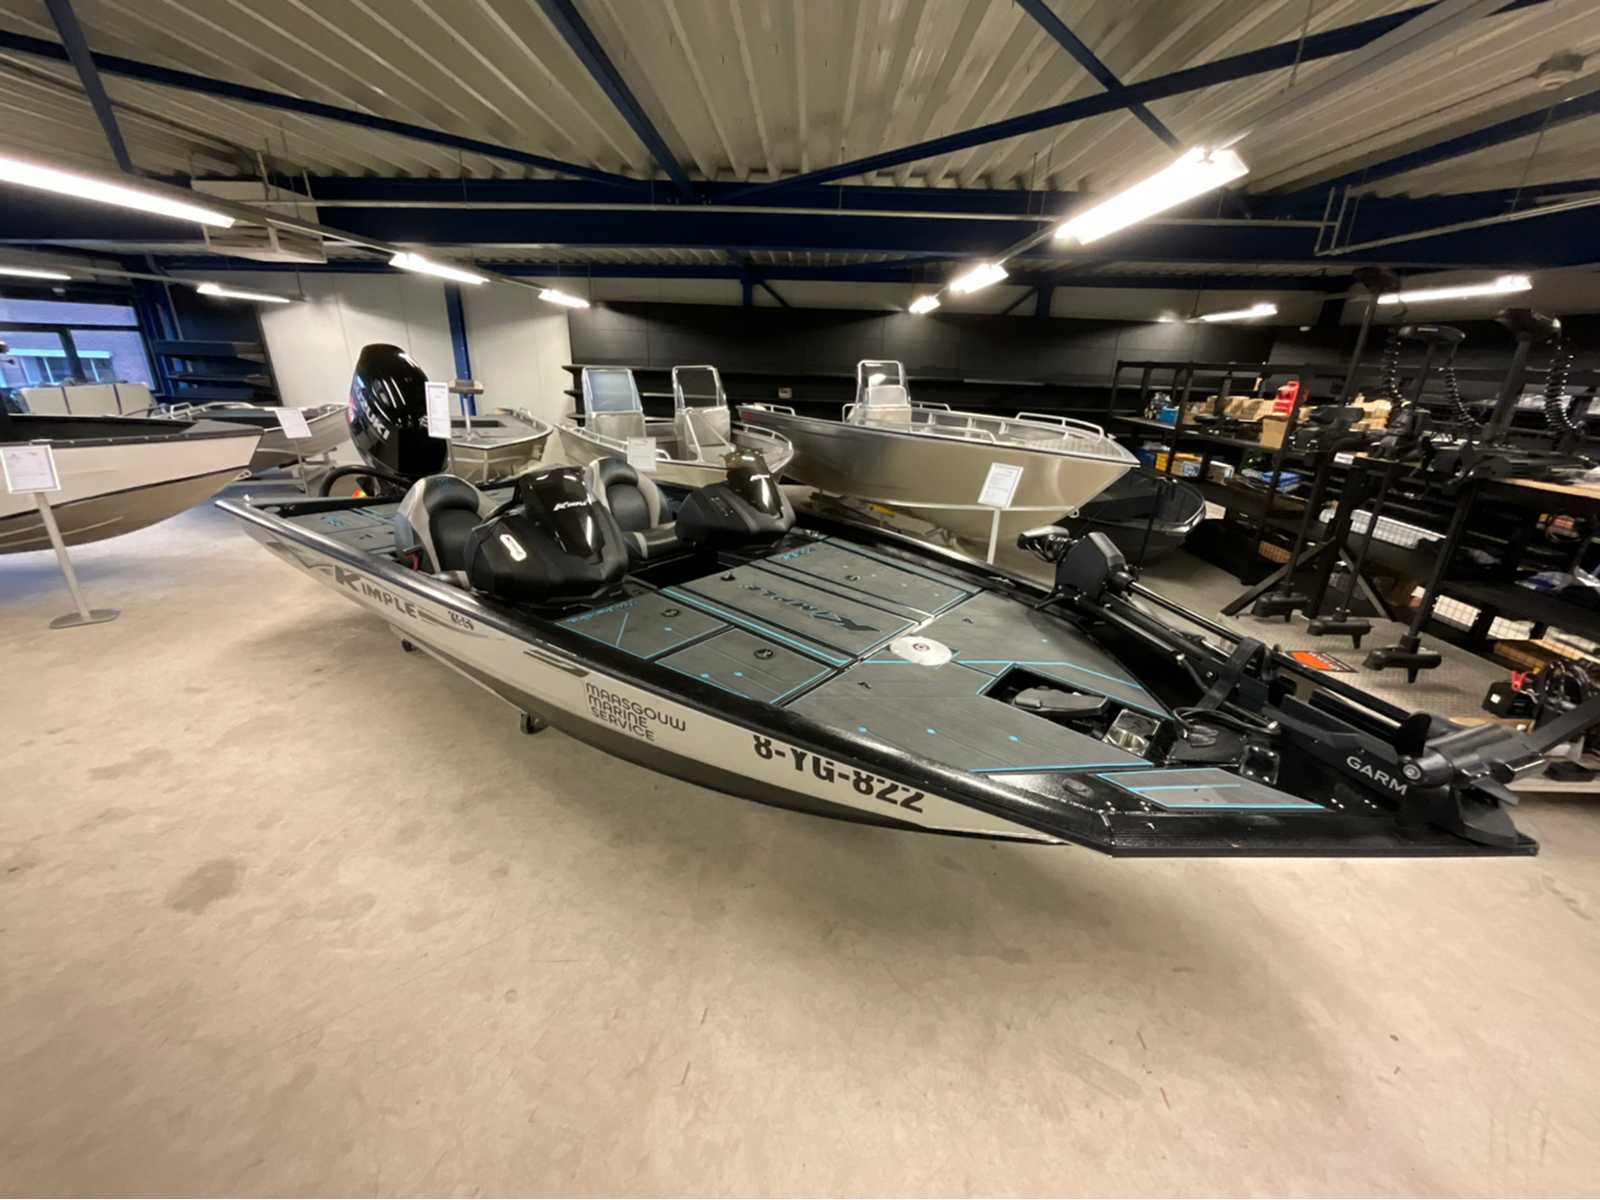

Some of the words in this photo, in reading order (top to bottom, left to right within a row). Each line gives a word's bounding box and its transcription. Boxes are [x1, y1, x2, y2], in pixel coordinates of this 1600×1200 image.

[334, 564, 418, 620] KIMPLE
[586, 682, 686, 732] MAASGOUW
[588, 694, 648, 730] MARINE
[591, 706, 655, 742] SERVICE
[753, 734, 925, 813] 8-YG-822
